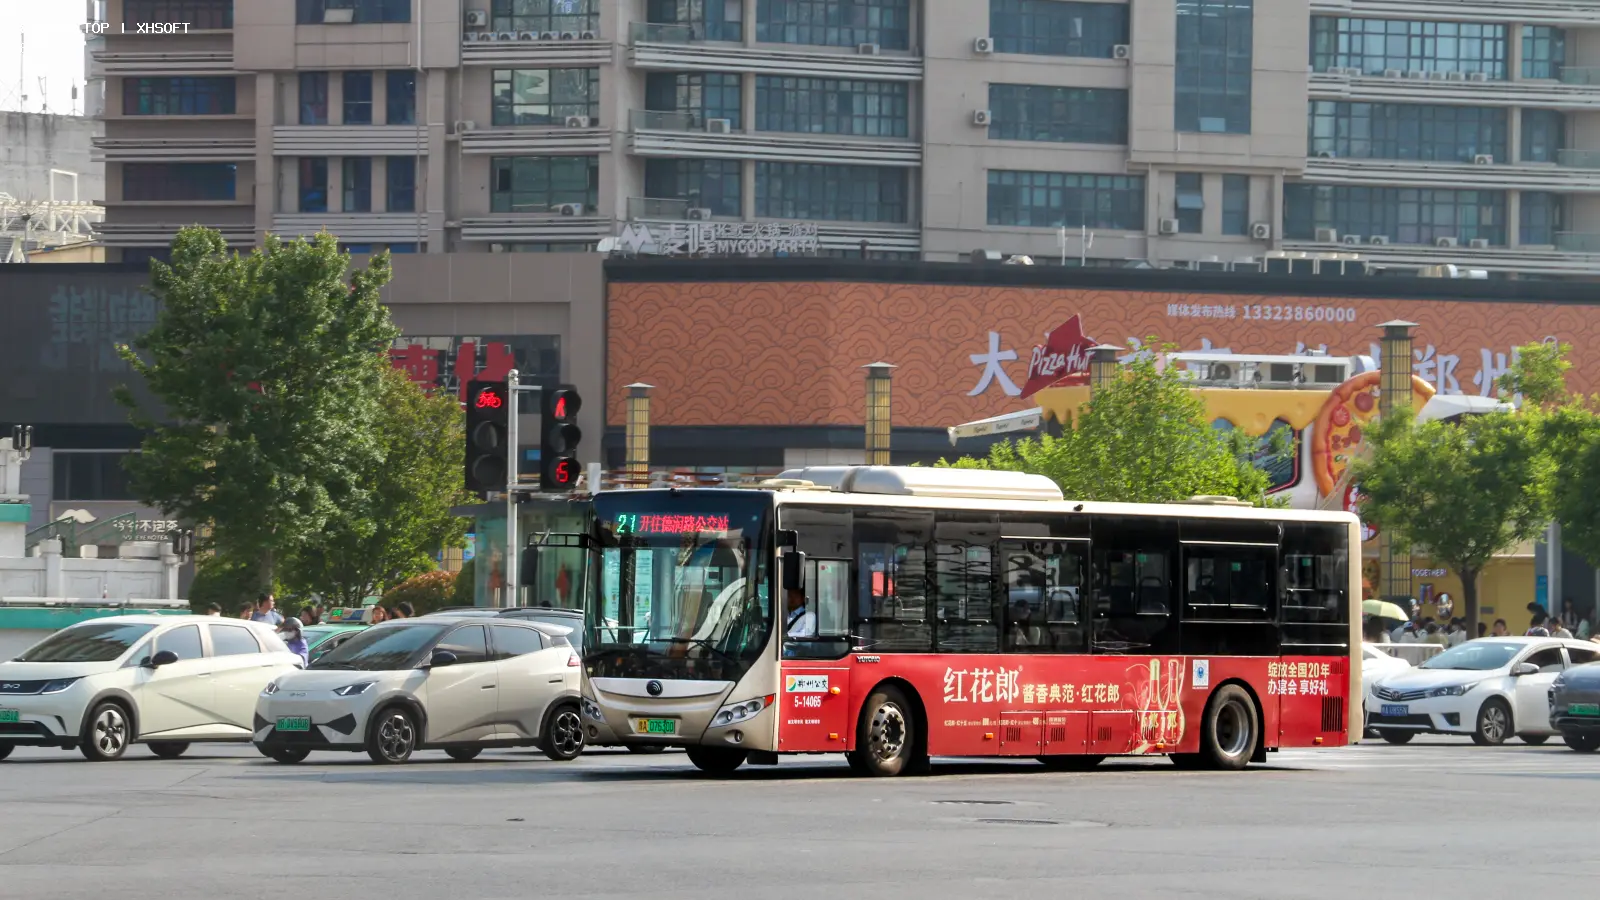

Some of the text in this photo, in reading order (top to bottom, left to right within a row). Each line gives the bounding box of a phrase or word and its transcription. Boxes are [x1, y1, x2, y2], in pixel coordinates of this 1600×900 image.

[1243, 305, 1356, 321] 13323860000
[1028, 347, 1066, 378] Pizza
[1066, 343, 1097, 373] Hut
[616, 514, 636, 533] 21
[1267, 661, 1330, 678] 绽放全国20年
[943, 666, 1120, 704] 红花郎 酱香典范·红花郎
[1267, 679, 1329, 695] 办宴会 享好礼
[794, 696, 822, 708] 5-14065
